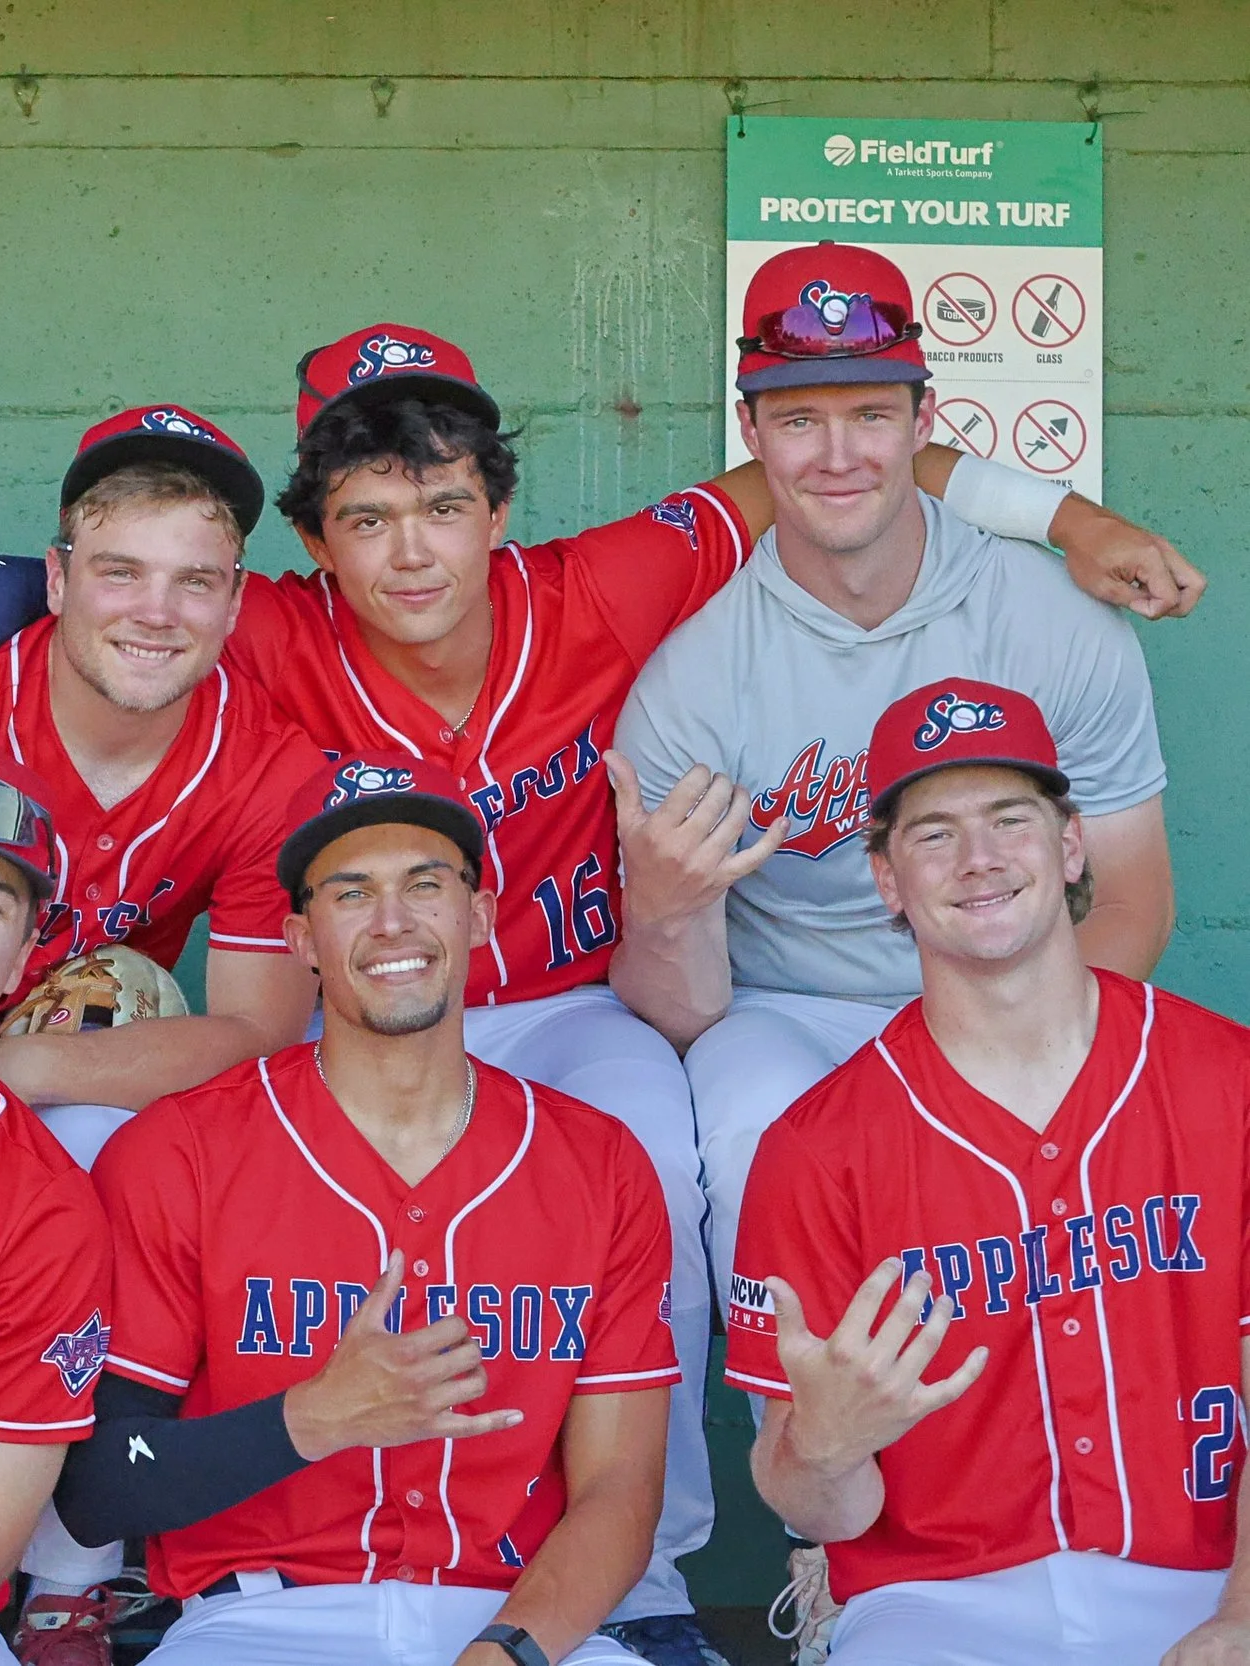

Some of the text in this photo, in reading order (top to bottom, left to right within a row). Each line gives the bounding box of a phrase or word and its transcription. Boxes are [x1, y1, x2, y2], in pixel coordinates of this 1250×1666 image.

[860, 139, 994, 165] FieldTurf
[887, 168, 993, 179] A Tarkett Sports Company
[760, 197, 1071, 227] PROTECT YOUR TURF
[958, 352, 1004, 363] PRODUCTS
[1036, 353, 1063, 365] GLASS
[913, 692, 1007, 752] Sox
[532, 851, 616, 972] 16
